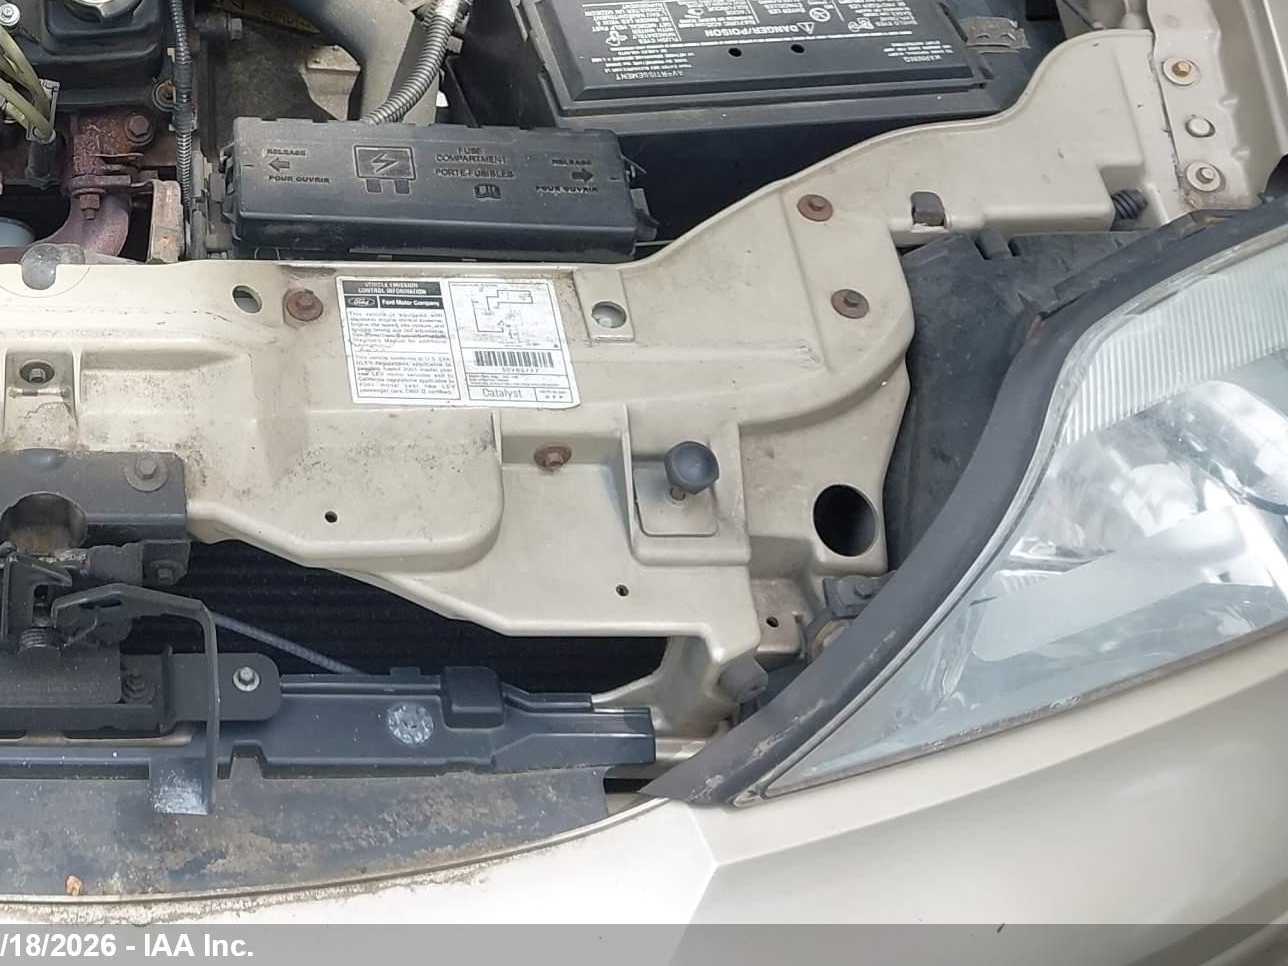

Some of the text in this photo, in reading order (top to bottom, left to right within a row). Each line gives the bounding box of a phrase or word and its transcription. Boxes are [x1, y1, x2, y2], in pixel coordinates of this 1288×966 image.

[704, 25, 800, 37] DANGER/POISON
[458, 147, 482, 155] FUSE
[435, 154, 507, 165] COMPARTMENT
[268, 175, 331, 185] POUR OUVRIR
[413, 300, 440, 308] Company
[482, 388, 523, 399] Catalyst
